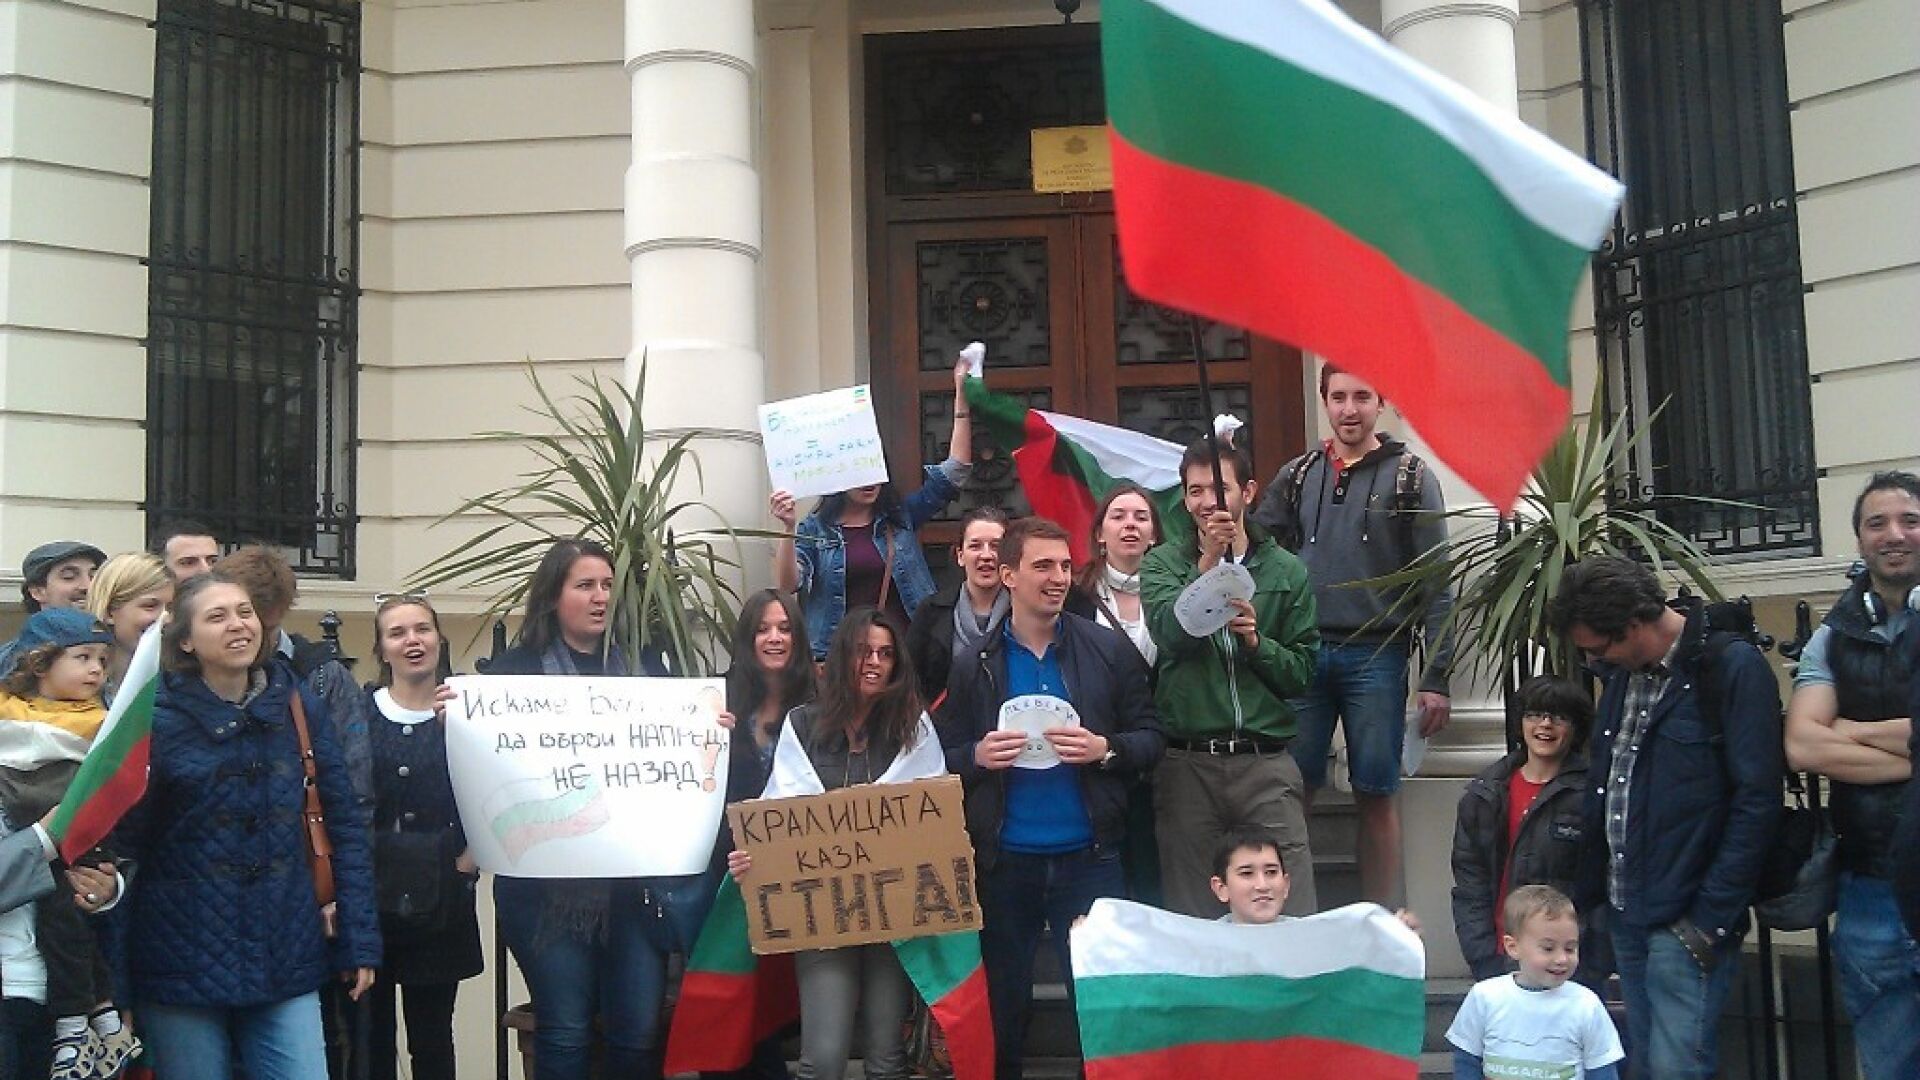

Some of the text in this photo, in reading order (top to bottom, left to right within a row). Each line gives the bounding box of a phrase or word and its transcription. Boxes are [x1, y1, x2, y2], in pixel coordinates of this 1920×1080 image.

[495, 732, 526, 753] да
[539, 732, 616, 757] върви
[552, 763, 591, 791] НЕ
[739, 790, 942, 846] КРАЛИЦАТА
[796, 841, 871, 872] КАЗА
[758, 856, 974, 940] СТИГА!
